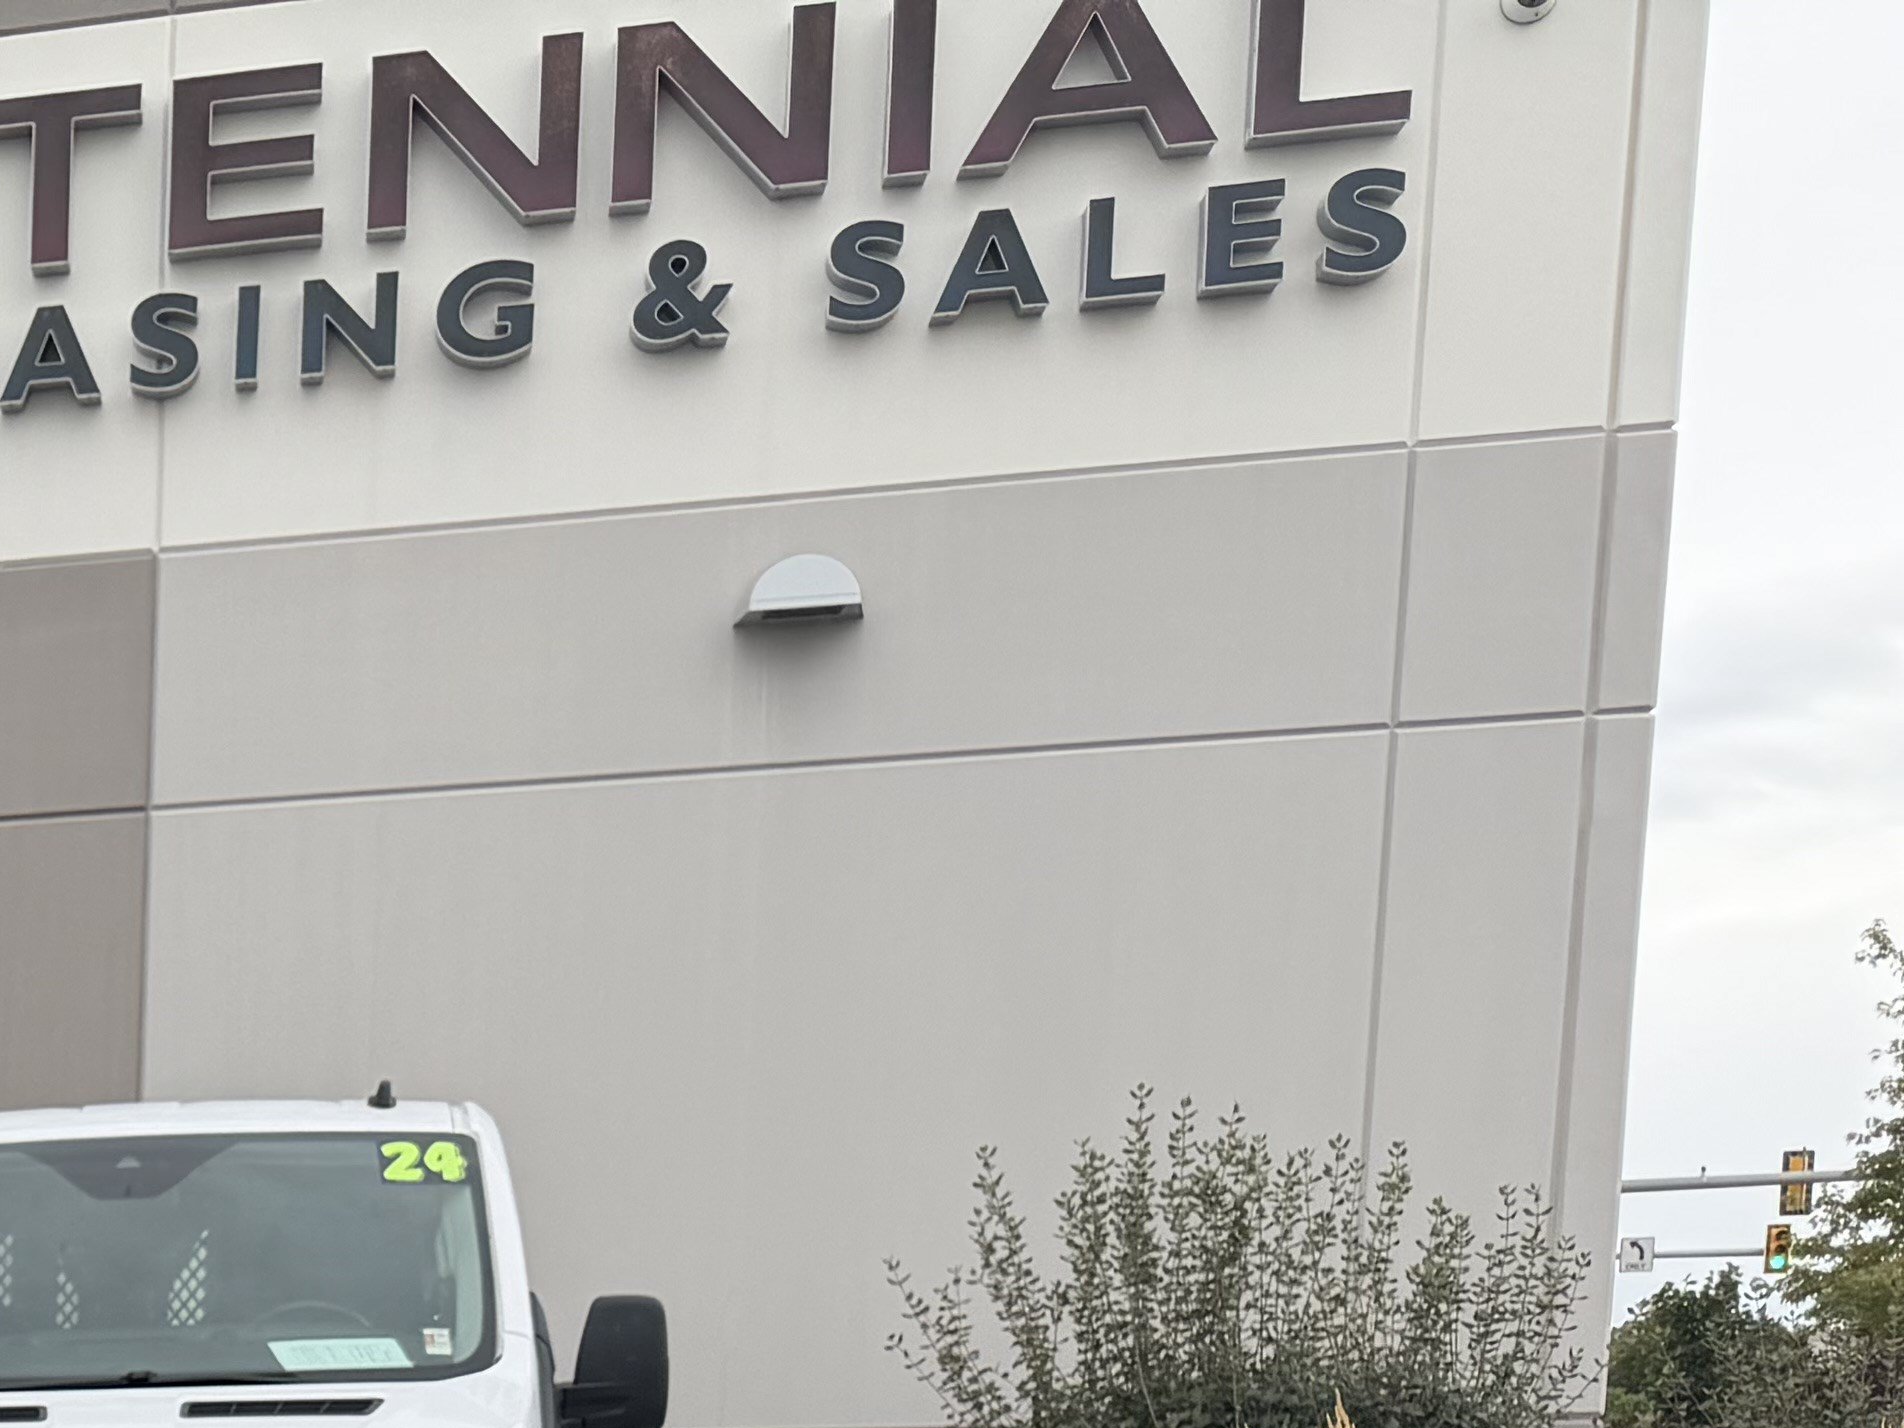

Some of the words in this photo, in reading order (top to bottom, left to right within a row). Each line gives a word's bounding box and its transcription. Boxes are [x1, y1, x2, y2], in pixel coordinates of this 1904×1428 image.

[628, 239, 733, 353] &
[825, 167, 1407, 334] SALES
[380, 1141, 468, 1182] 24
